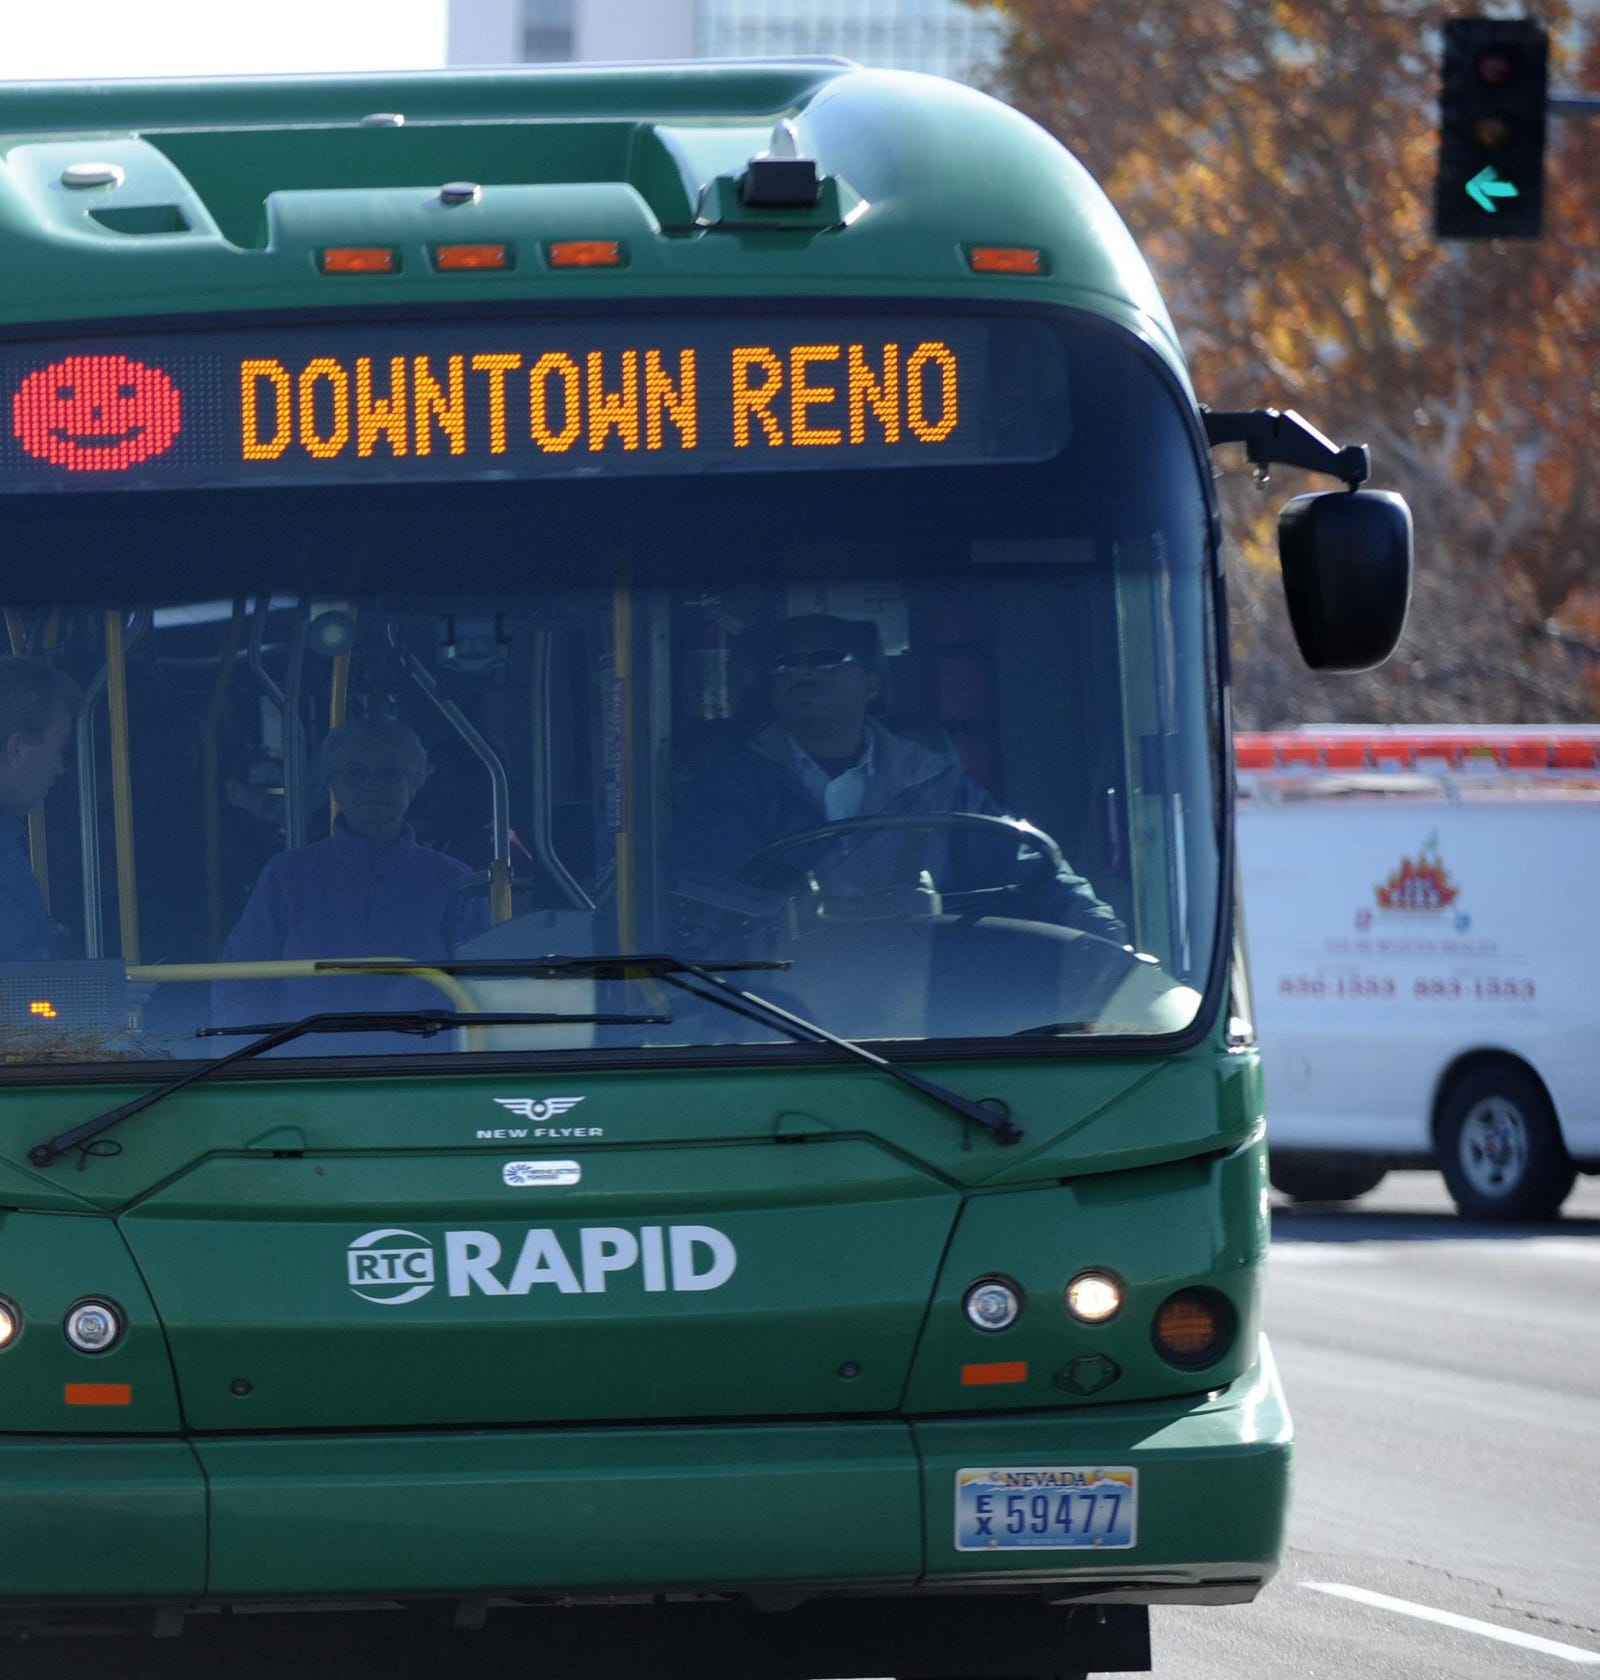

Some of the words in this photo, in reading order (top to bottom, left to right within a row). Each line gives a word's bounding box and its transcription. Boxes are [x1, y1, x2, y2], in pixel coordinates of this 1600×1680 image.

[241, 349, 696, 459] DOWNTOWN
[732, 343, 957, 447] RENO
[476, 1129, 528, 1139] NEW
[534, 1127, 604, 1138] FLYER
[355, 1251, 430, 1280] RTC
[444, 1225, 738, 1297] RAPID
[1005, 1471, 1089, 1488] NEVADA
[1006, 1493, 1122, 1535] 59477
